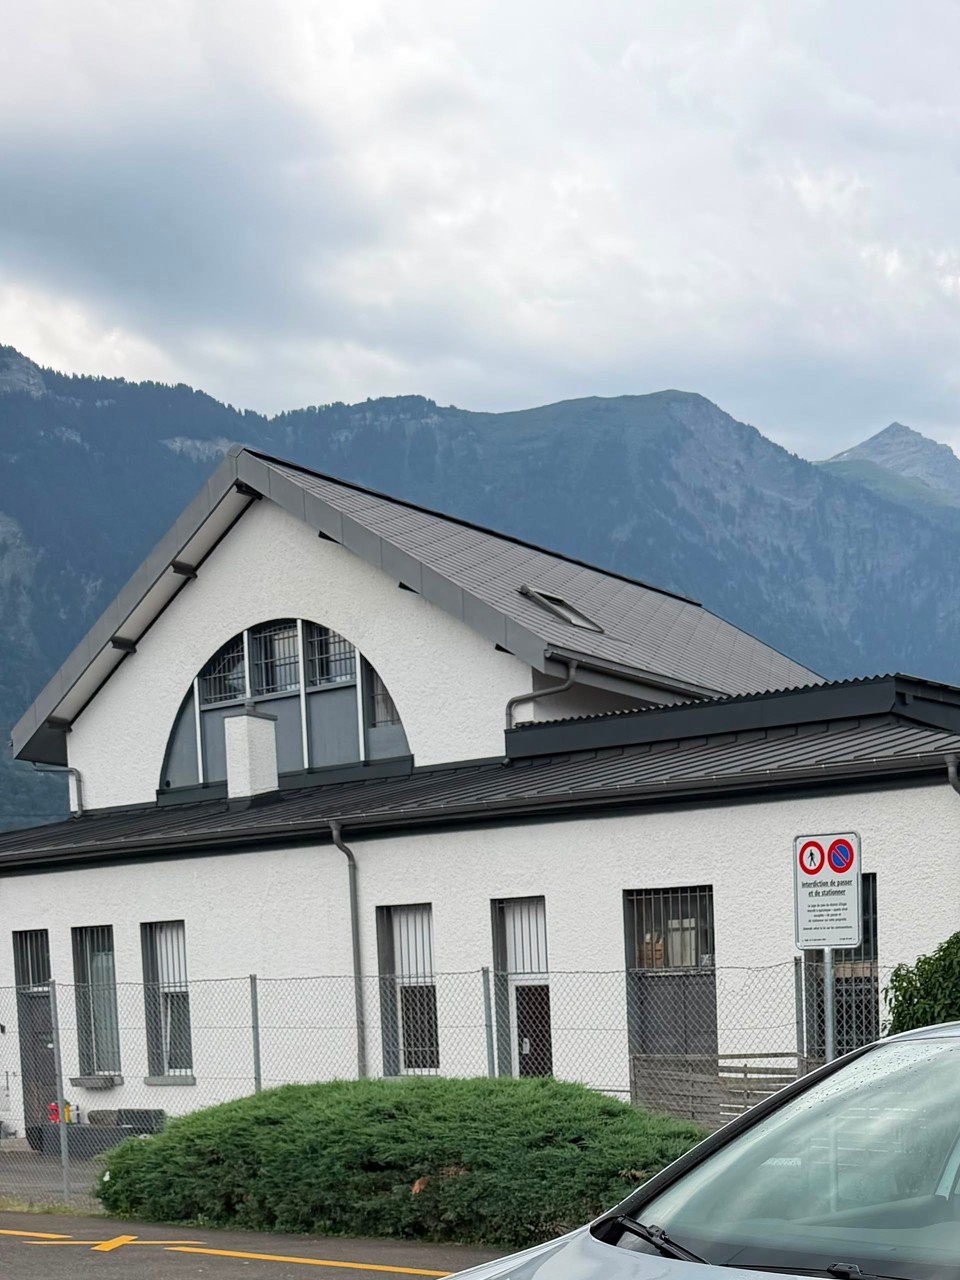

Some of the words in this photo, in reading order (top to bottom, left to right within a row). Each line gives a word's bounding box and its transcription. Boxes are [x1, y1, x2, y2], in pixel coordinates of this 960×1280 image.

[802, 880, 828, 888] Interdiction
[830, 879, 836, 887] de
[837, 879, 852, 887] passer
[815, 889, 820, 897] de
[821, 889, 846, 897] stationner
